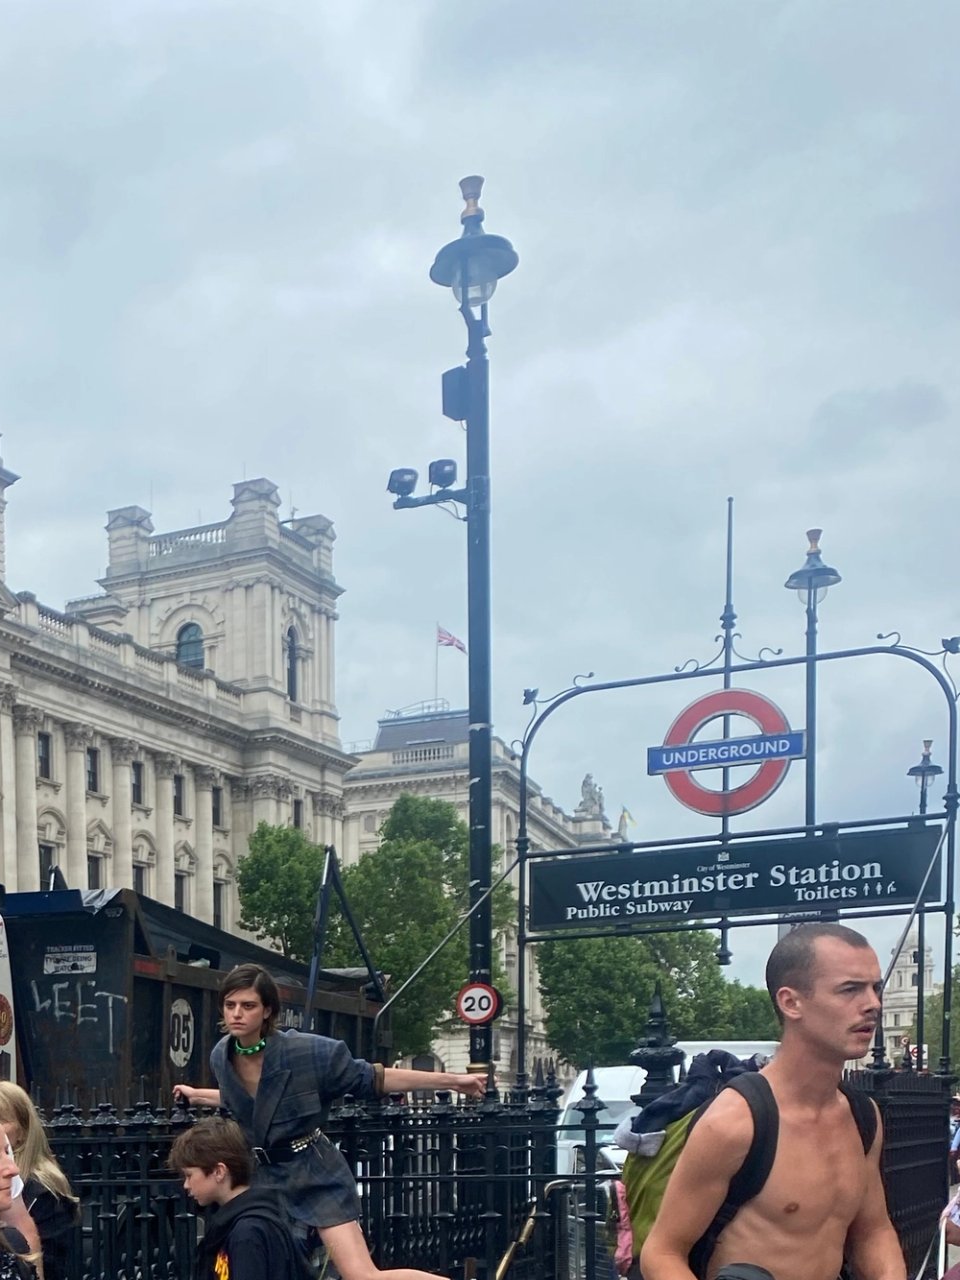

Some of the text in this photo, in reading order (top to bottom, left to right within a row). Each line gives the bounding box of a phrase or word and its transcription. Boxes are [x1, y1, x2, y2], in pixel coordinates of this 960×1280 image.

[662, 739, 790, 766] UNDERGROUND
[696, 865, 708, 873] City
[716, 862, 751, 870] Westminster
[576, 860, 883, 903] Westminster Station
[794, 884, 857, 902] Toilets
[566, 899, 694, 920] Public Subway
[464, 995, 491, 1012] 20
[171, 1012, 191, 1054] 05
